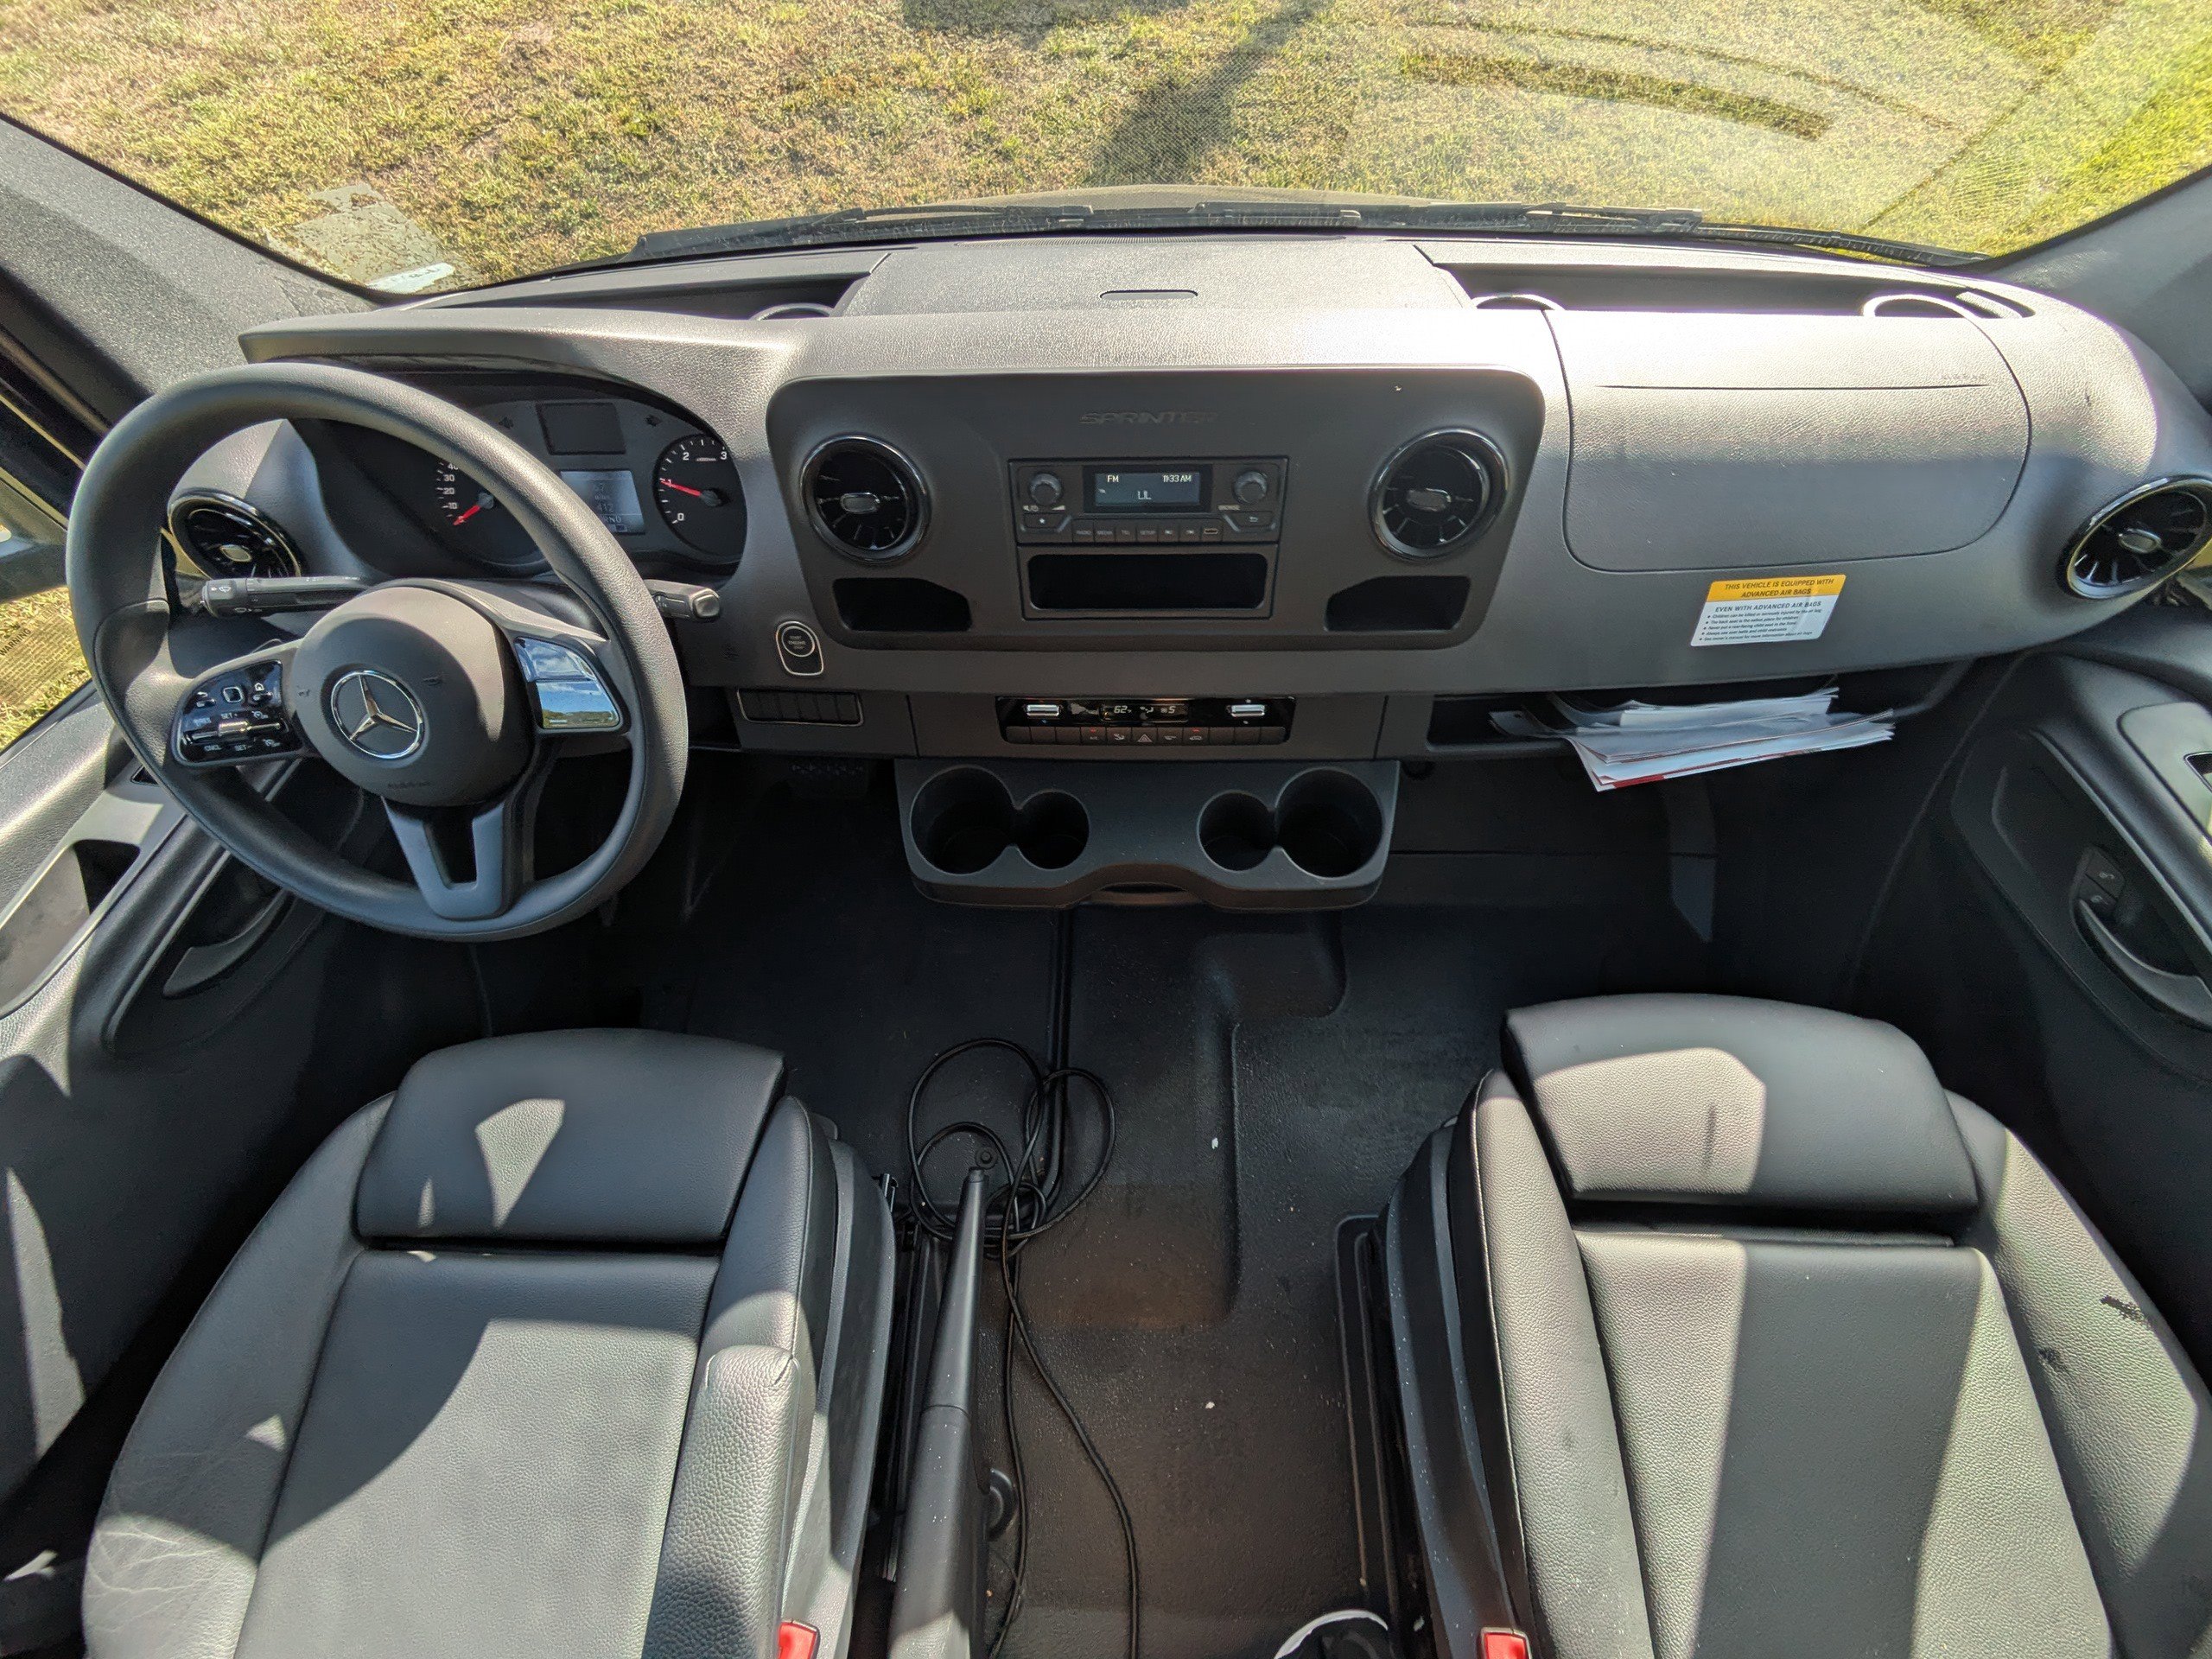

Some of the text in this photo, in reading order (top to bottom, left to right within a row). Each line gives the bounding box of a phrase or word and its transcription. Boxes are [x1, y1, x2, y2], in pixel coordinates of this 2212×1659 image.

[683, 452, 690, 461] 2
[721, 451, 728, 461] 3
[1107, 474, 1119, 483] FM
[1179, 474, 1192, 483] AM
[677, 512, 684, 521] 0
